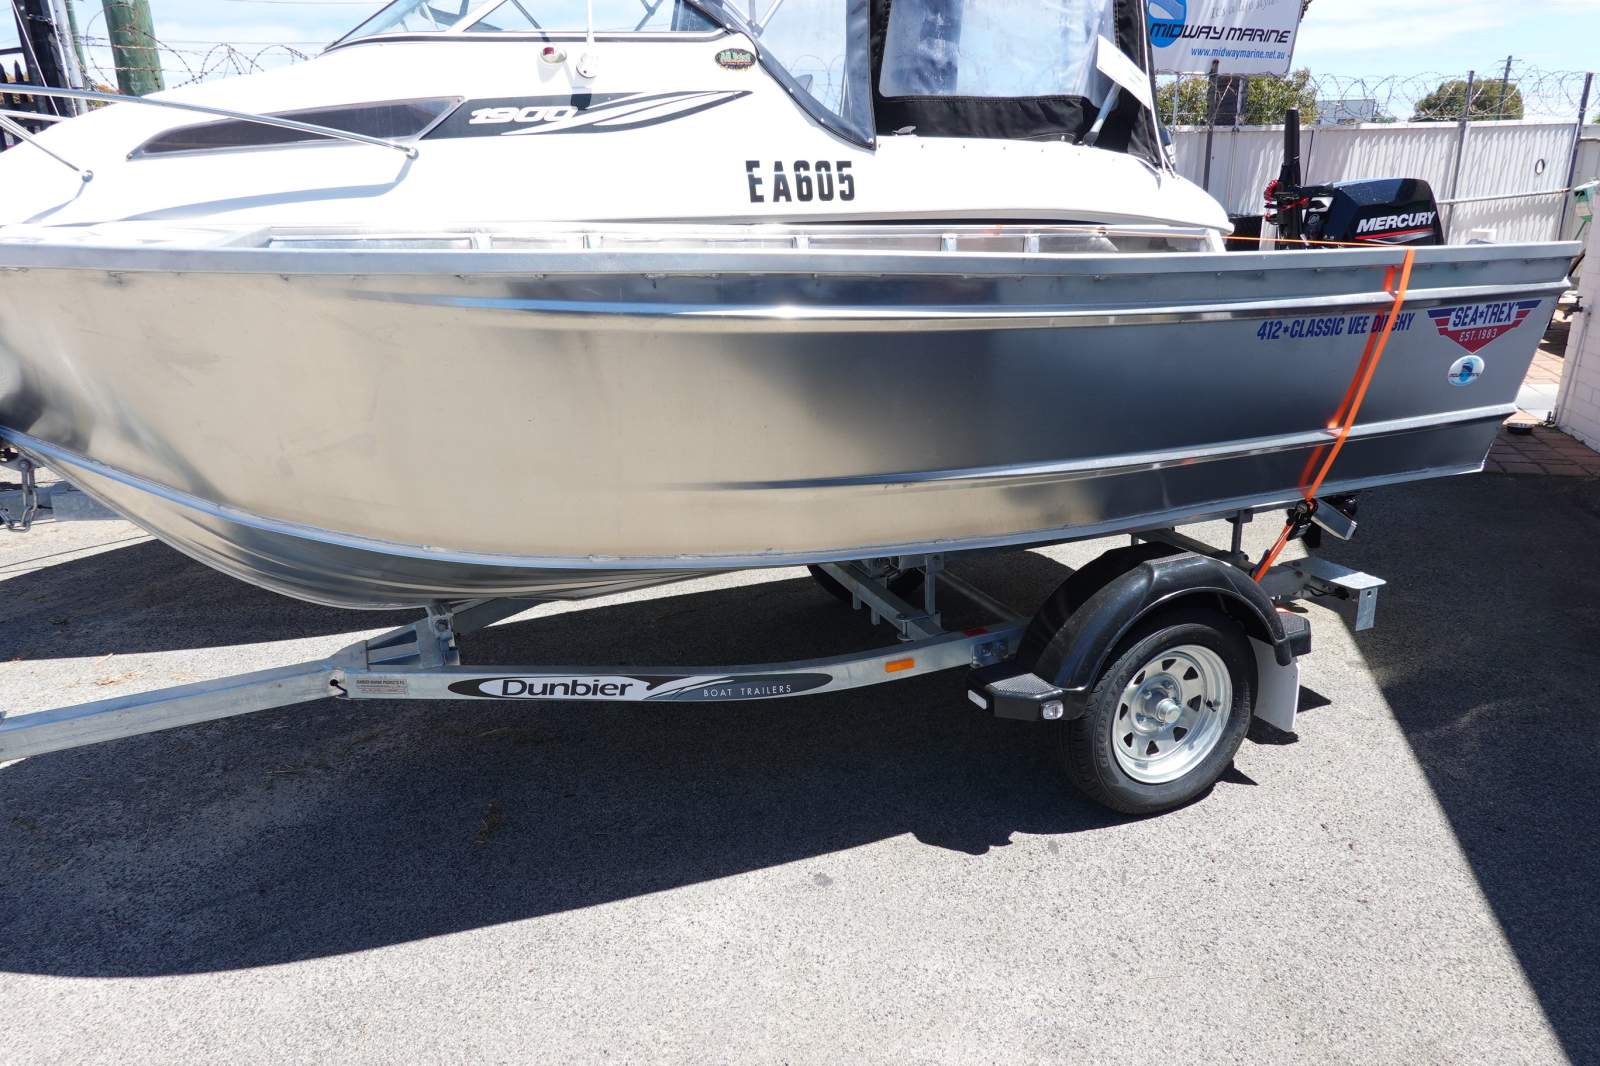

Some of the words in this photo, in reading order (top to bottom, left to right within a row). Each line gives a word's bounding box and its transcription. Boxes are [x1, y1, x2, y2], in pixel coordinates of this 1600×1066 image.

[1150, 23, 1225, 40] MIDWAY
[1225, 27, 1291, 44] MARINE
[1191, 47, 1285, 60] www.midwaymarine.net.au
[469, 105, 578, 124] 1900
[745, 160, 856, 203] EA605
[1357, 211, 1436, 233] MERCURY
[1347, 315, 1370, 335] VEE
[502, 679, 635, 697] Dunbier
[703, 688, 733, 697] BOAT
[740, 684, 792, 696] TRAILERS
